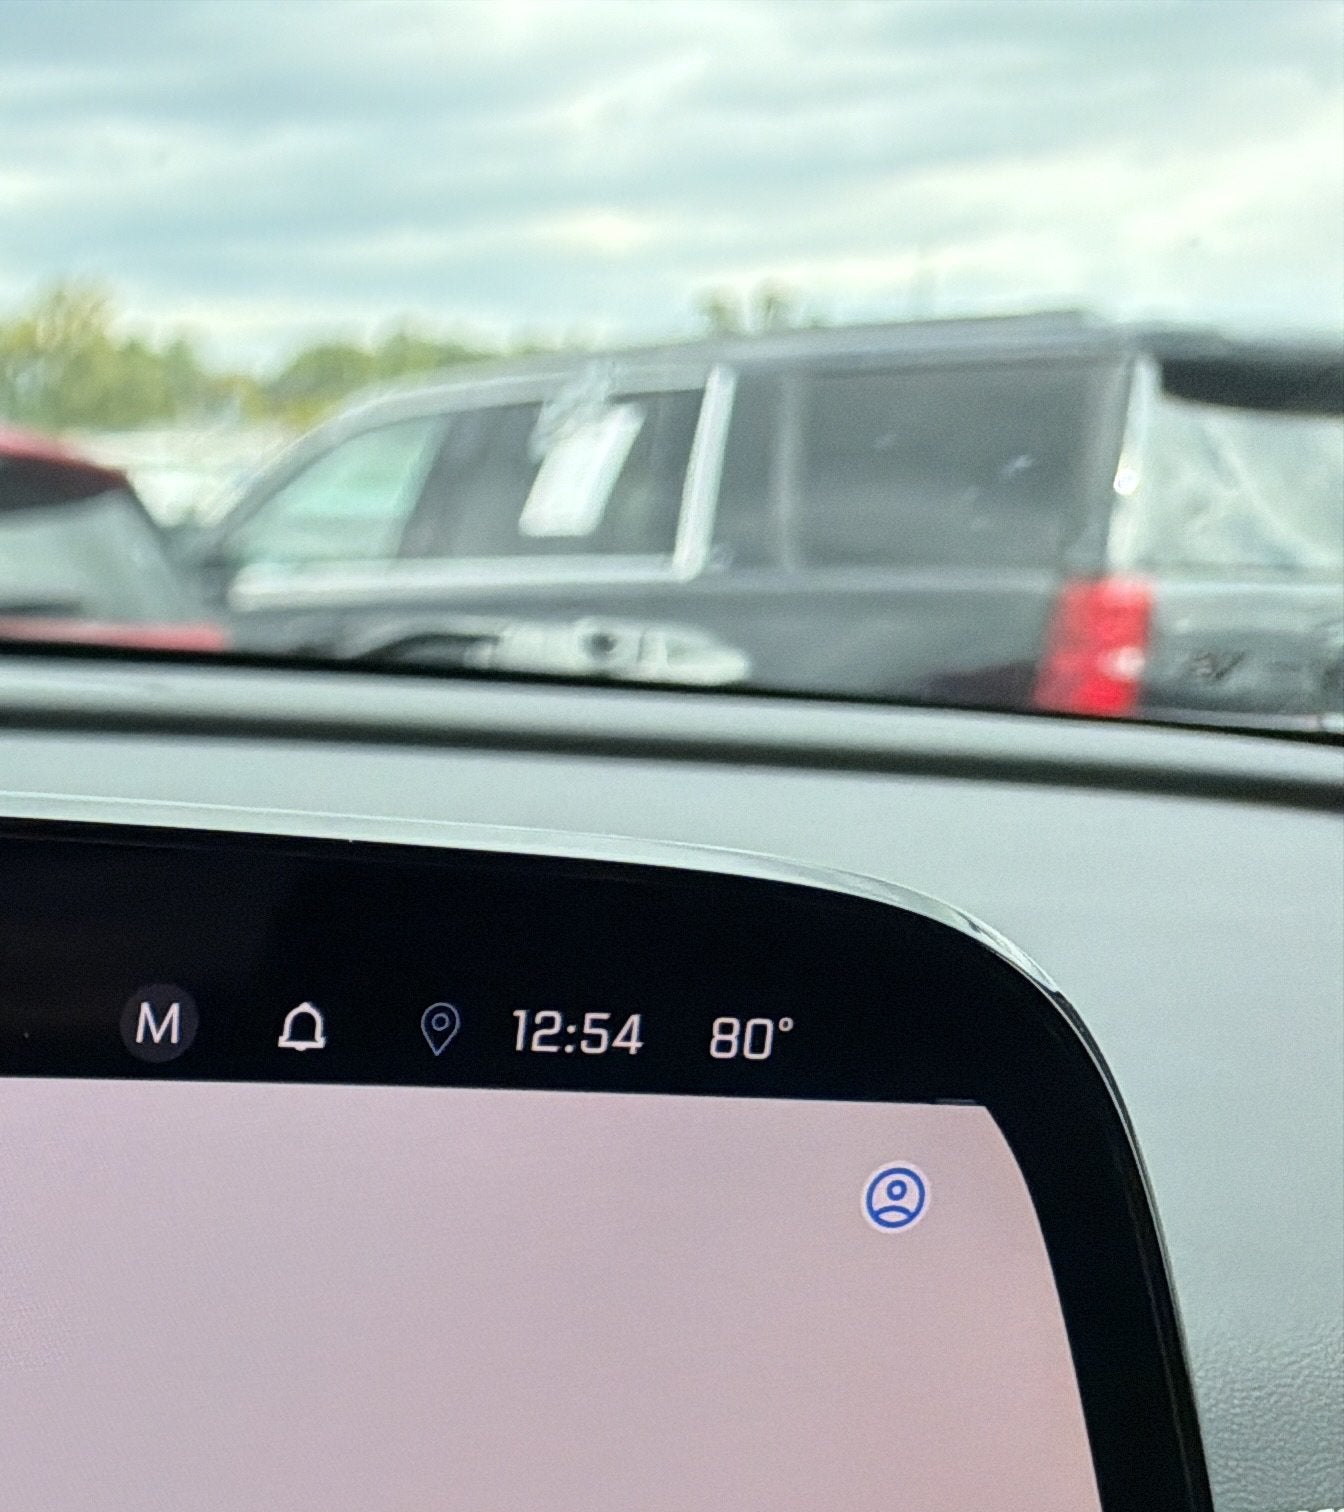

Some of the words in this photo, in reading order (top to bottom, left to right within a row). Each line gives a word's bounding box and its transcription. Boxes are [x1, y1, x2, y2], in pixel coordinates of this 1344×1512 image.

[135, 1001, 180, 1044] M
[512, 1009, 644, 1055] 12:54
[709, 1016, 794, 1060] 80°
